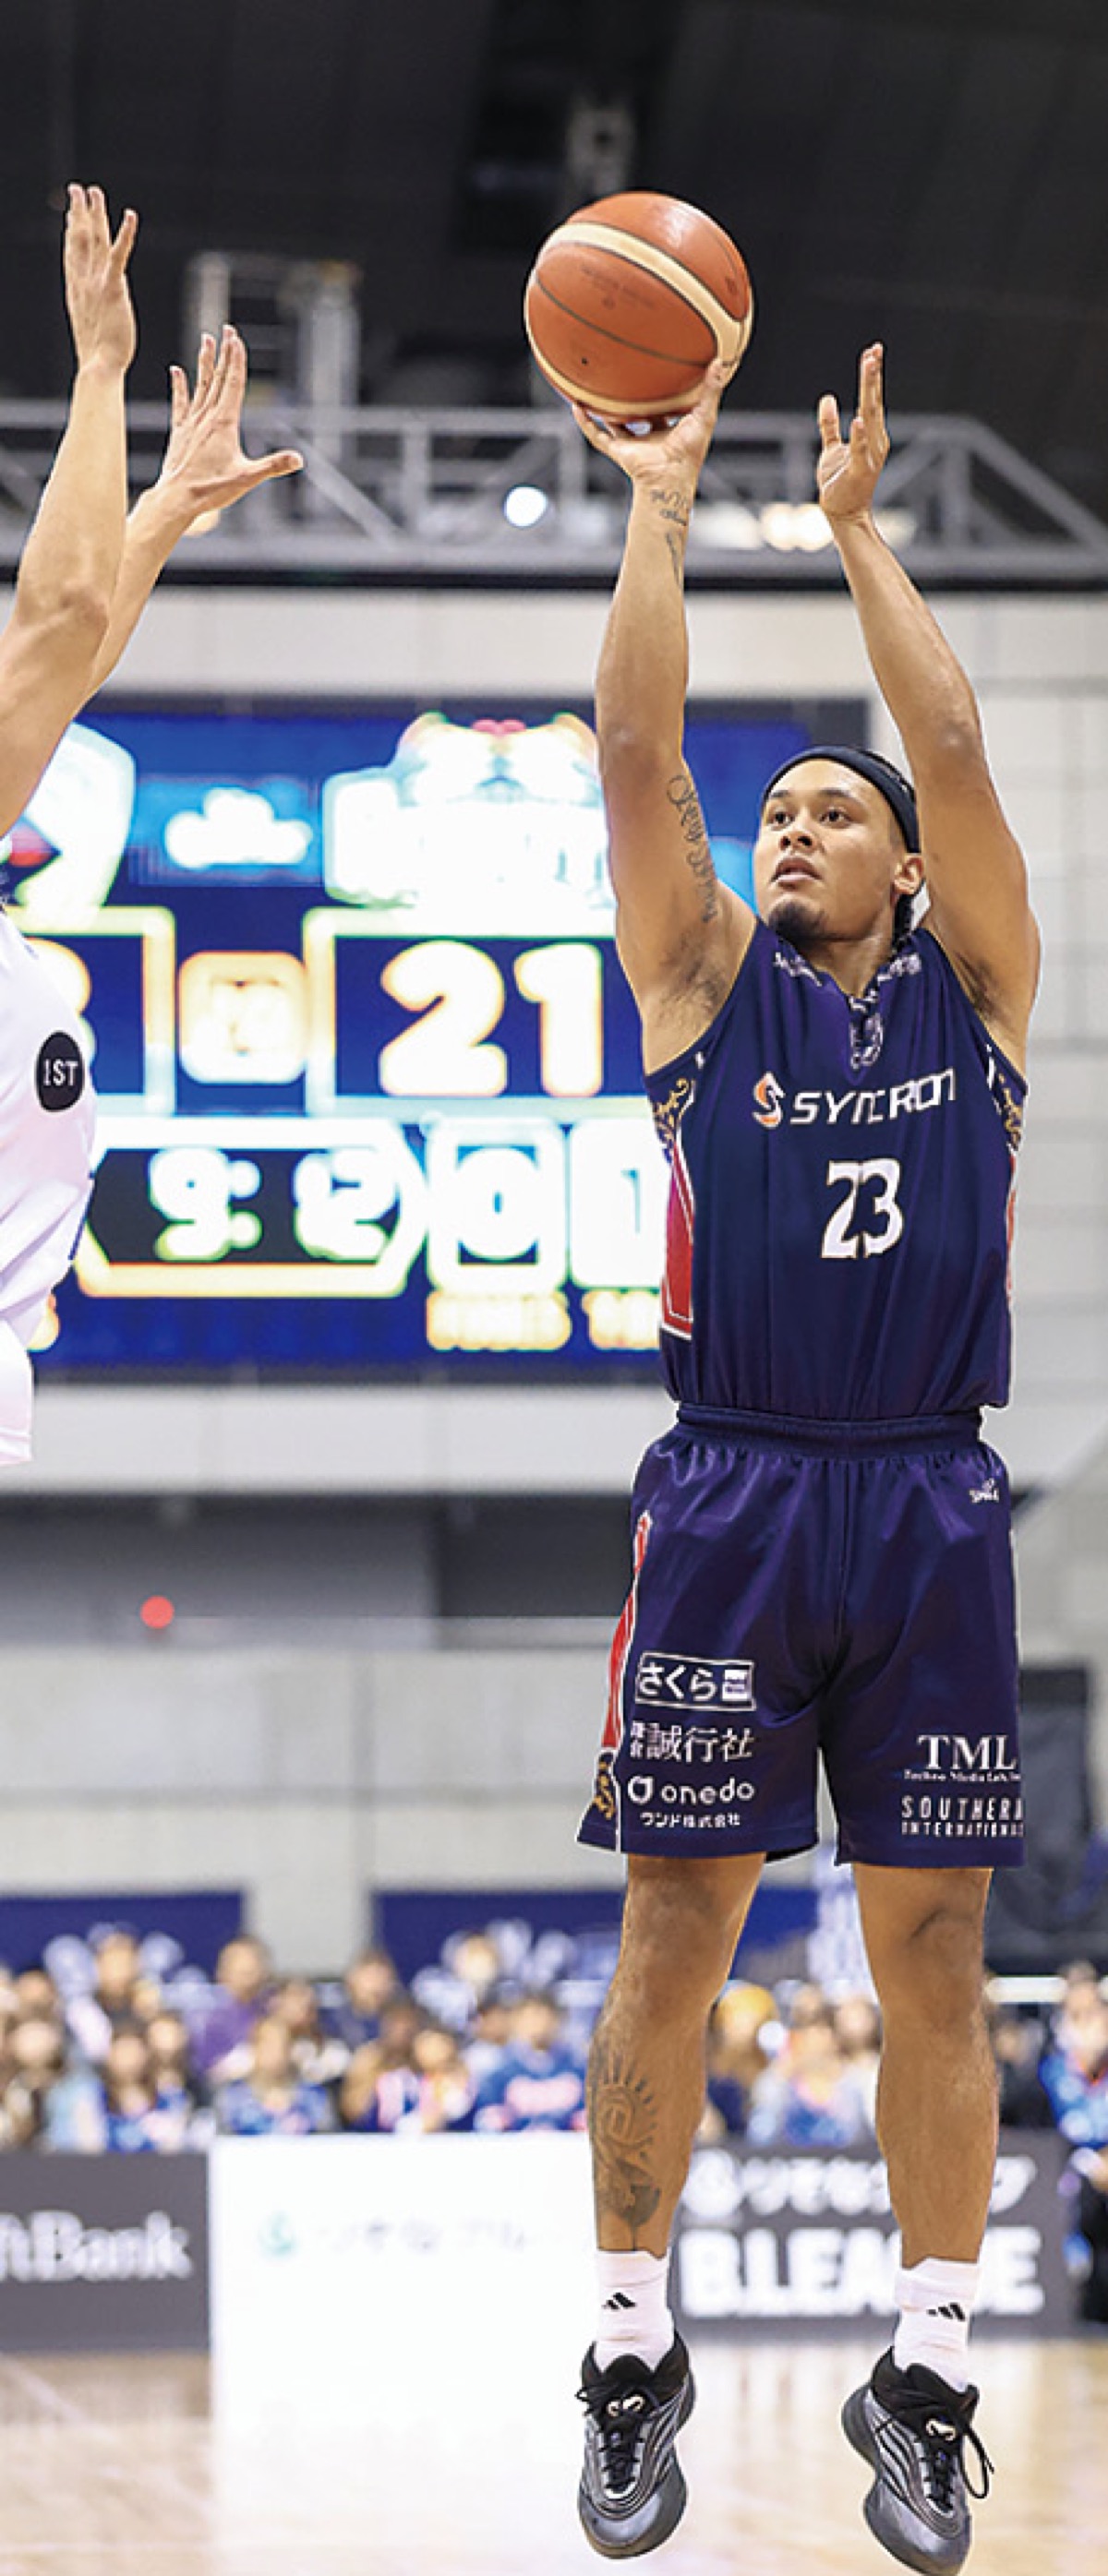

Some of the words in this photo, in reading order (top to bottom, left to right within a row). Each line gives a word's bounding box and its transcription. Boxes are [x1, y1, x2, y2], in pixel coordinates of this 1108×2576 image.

[379, 940, 604, 1096] 21
[821, 1157, 905, 1259] 23
[639, 1661, 717, 1703] さくら
[916, 1734, 1018, 1771] TML
[660, 1776, 755, 1805] onedo
[680, 2227, 1045, 2318] B.LEAE
